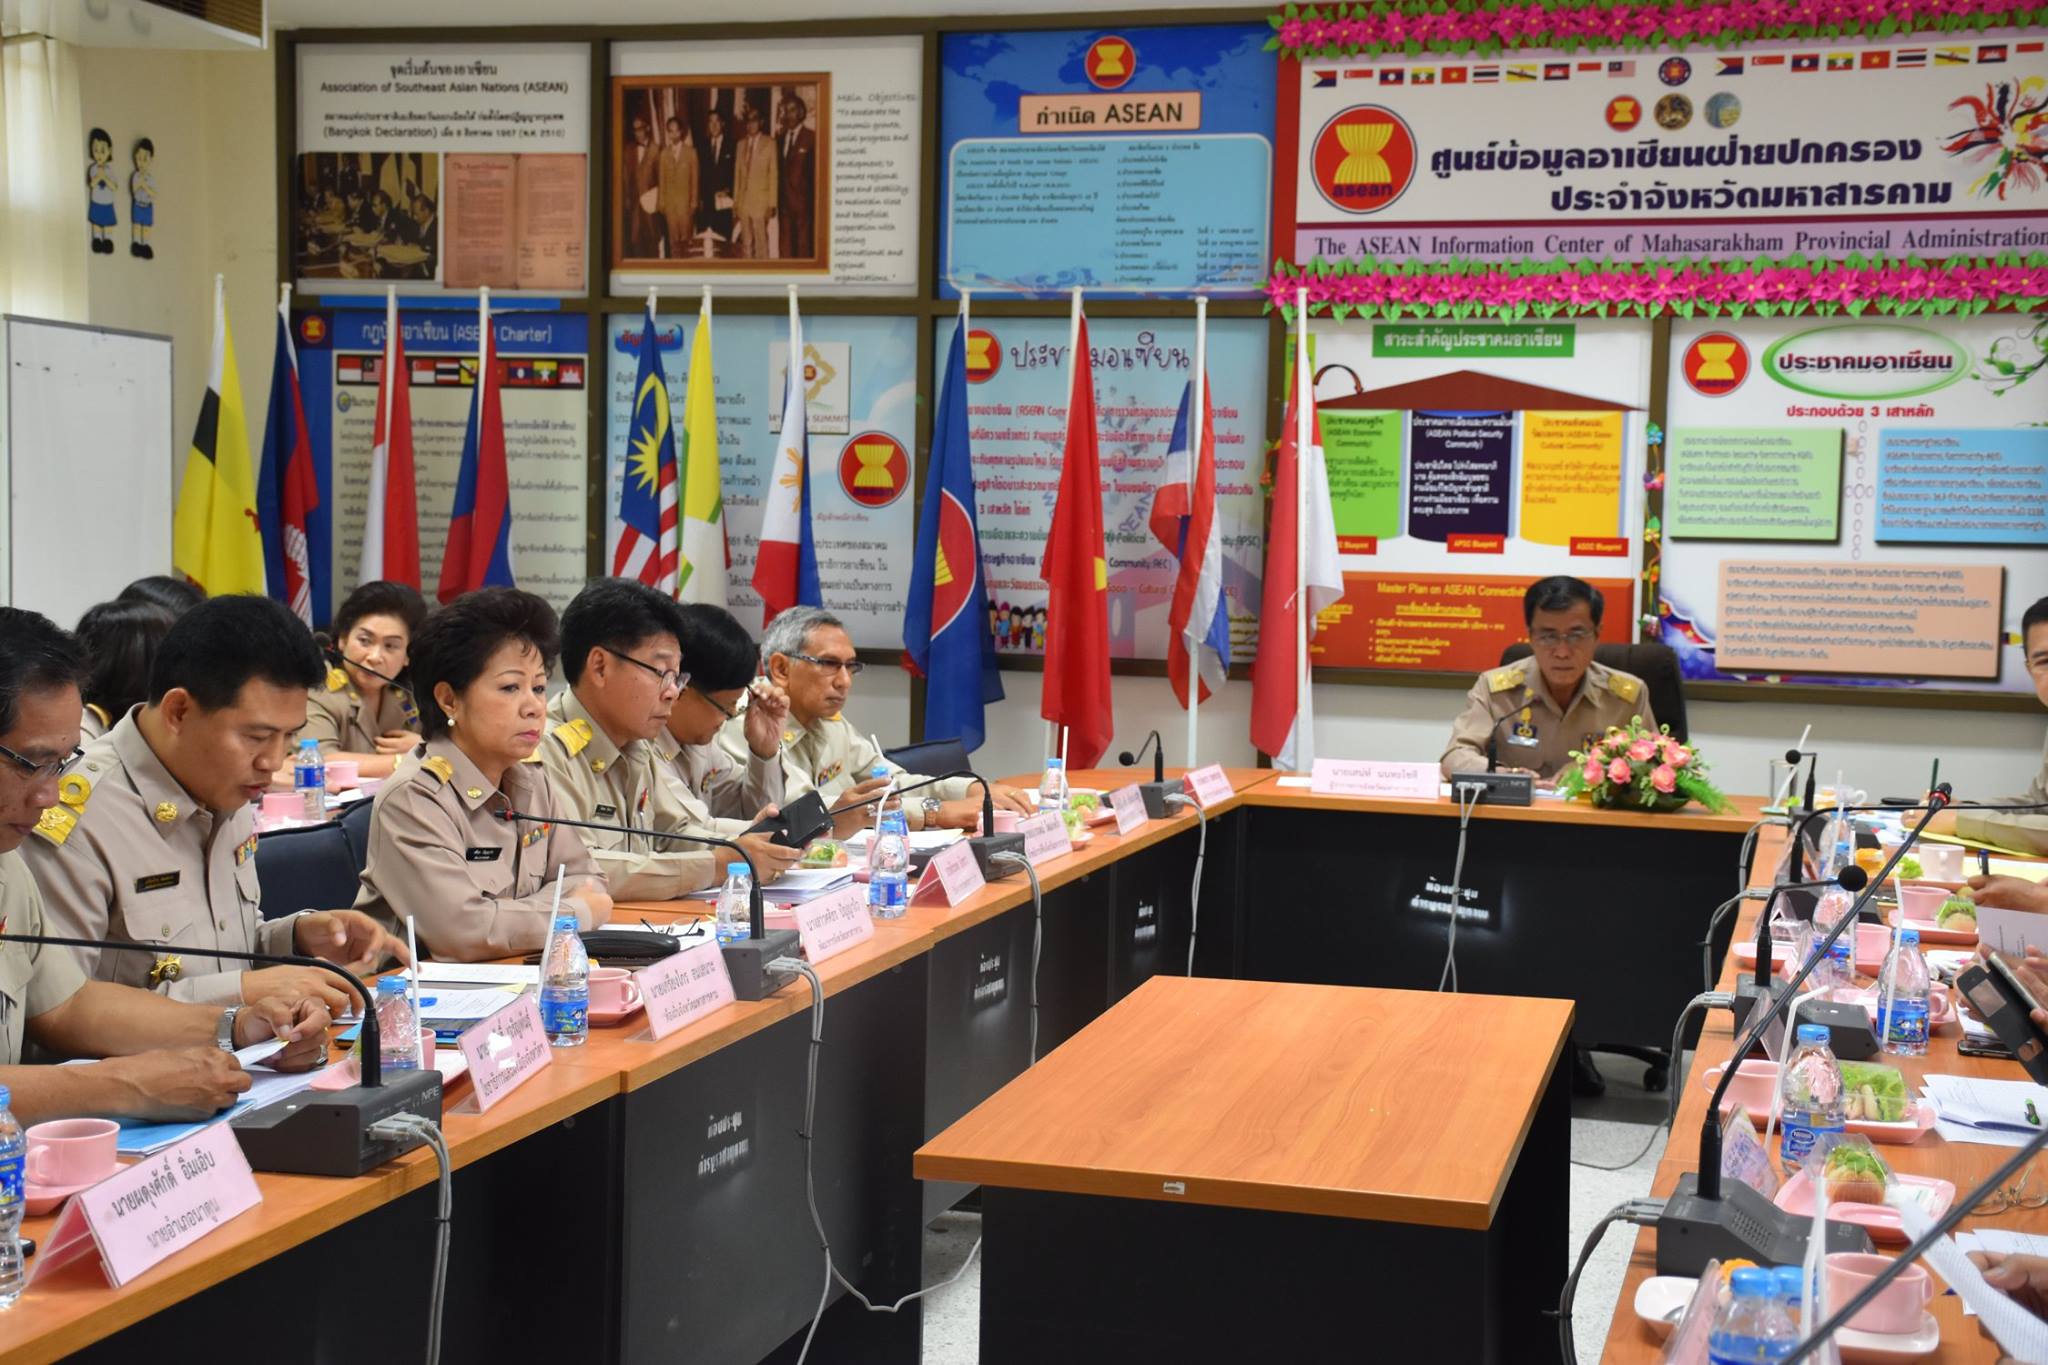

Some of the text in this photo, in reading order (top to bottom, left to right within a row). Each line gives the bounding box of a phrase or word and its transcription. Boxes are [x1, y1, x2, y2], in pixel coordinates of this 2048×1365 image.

[321, 82, 568, 94] Association of Southeast Asian Nations (ASEAN)
[1037, 102, 1182, 126] กำเนิด ASEAN
[323, 126, 370, 139] (Bangkok
[374, 126, 438, 139] Declaration)
[1431, 135, 1922, 179] ศูนย์ข้อมูลอาเซียนฝ่ายปกครอง
[1332, 183, 1393, 198] asean
[1551, 179, 1952, 211] ประจำจังหวัดมหาสารคาม
[1315, 227, 2048, 255] The ASEAN Information Center of Mahasarakham Provincial Administration
[1384, 328, 1563, 352] สาระสำคัญประชาคมอาเซียน
[1779, 350, 1953, 371] ประชาคมอาเซียน
[1787, 404, 1935, 417] ประกอบด้วย 3 เสาหลัก
[979, 504, 985, 514] 3
[1377, 582, 1406, 594] Master
[1408, 582, 1428, 595] Plan
[1430, 586, 1441, 594] on
[1444, 584, 1475, 595] ASEAN
[111, 1147, 216, 1219] นายผดุงศักดิ์ อิ่มเอิบ
[146, 1197, 221, 1248] นายอำเภอนาดูน
